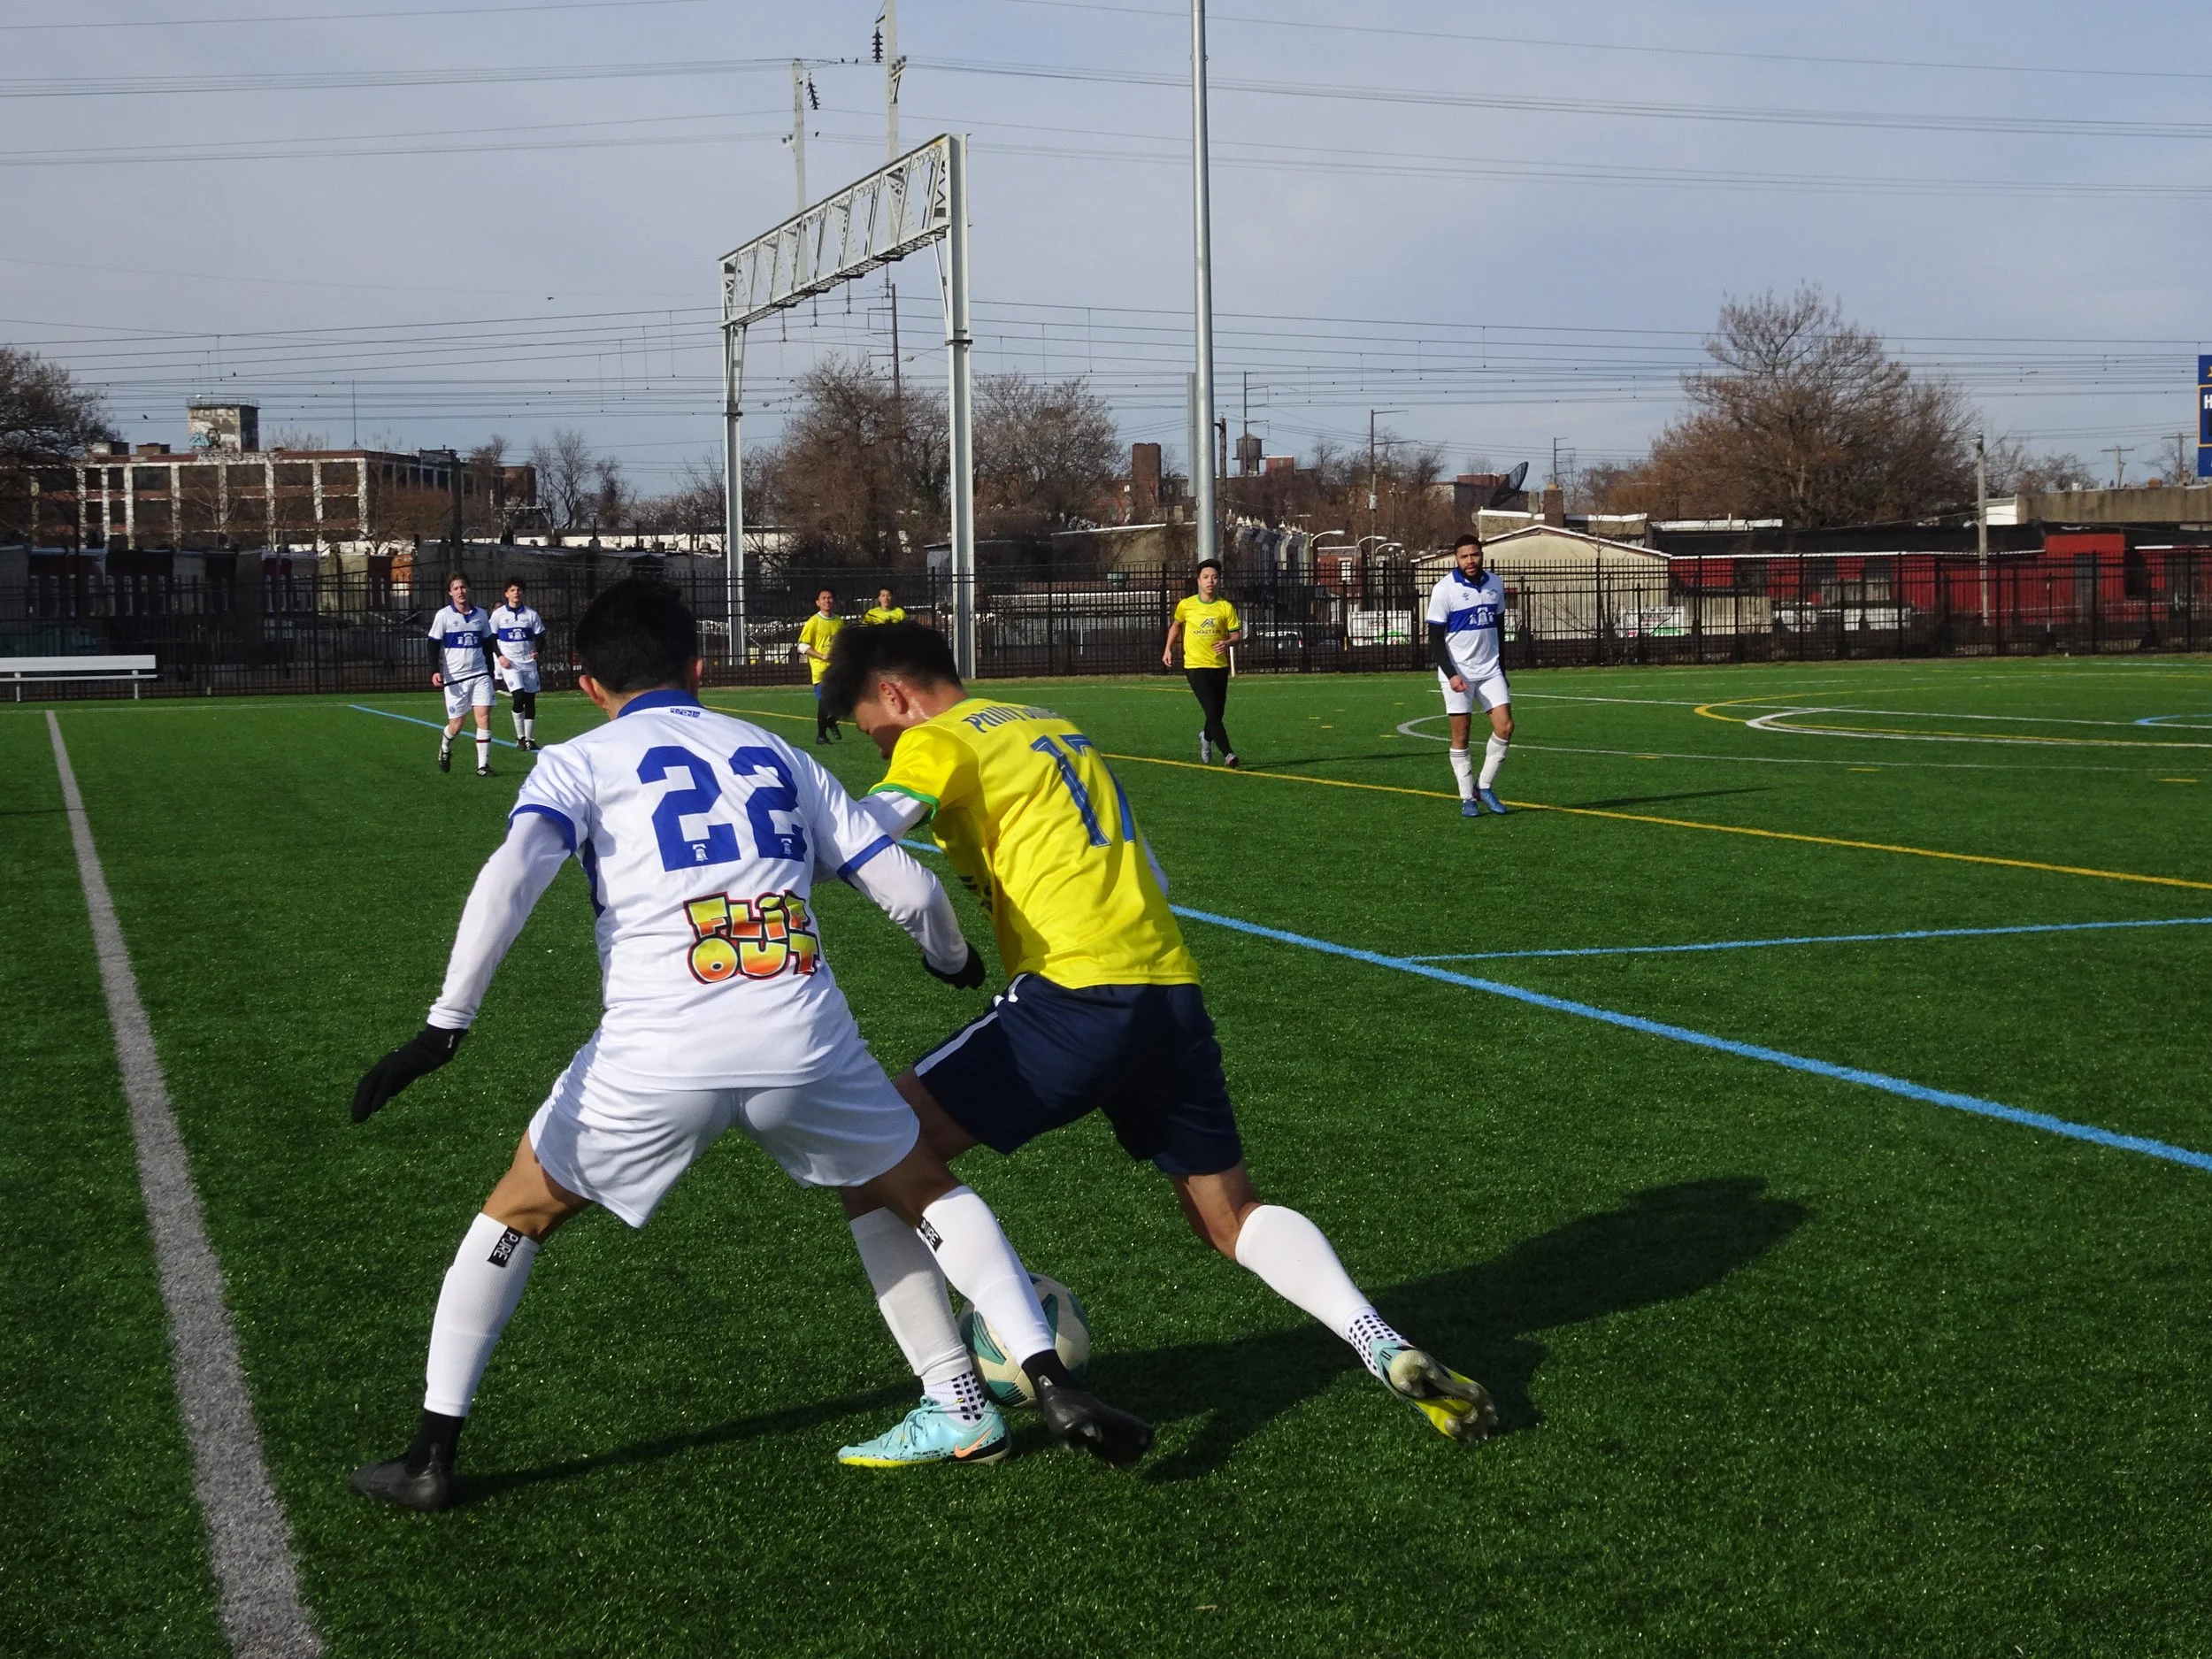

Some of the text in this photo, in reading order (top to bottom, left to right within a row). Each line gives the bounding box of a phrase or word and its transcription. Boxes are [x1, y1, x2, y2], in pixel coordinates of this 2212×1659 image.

[636, 746, 808, 872] 22
[1030, 733, 1136, 848] 17
[687, 931, 820, 984] OUT
[493, 1231, 518, 1260] PURE
